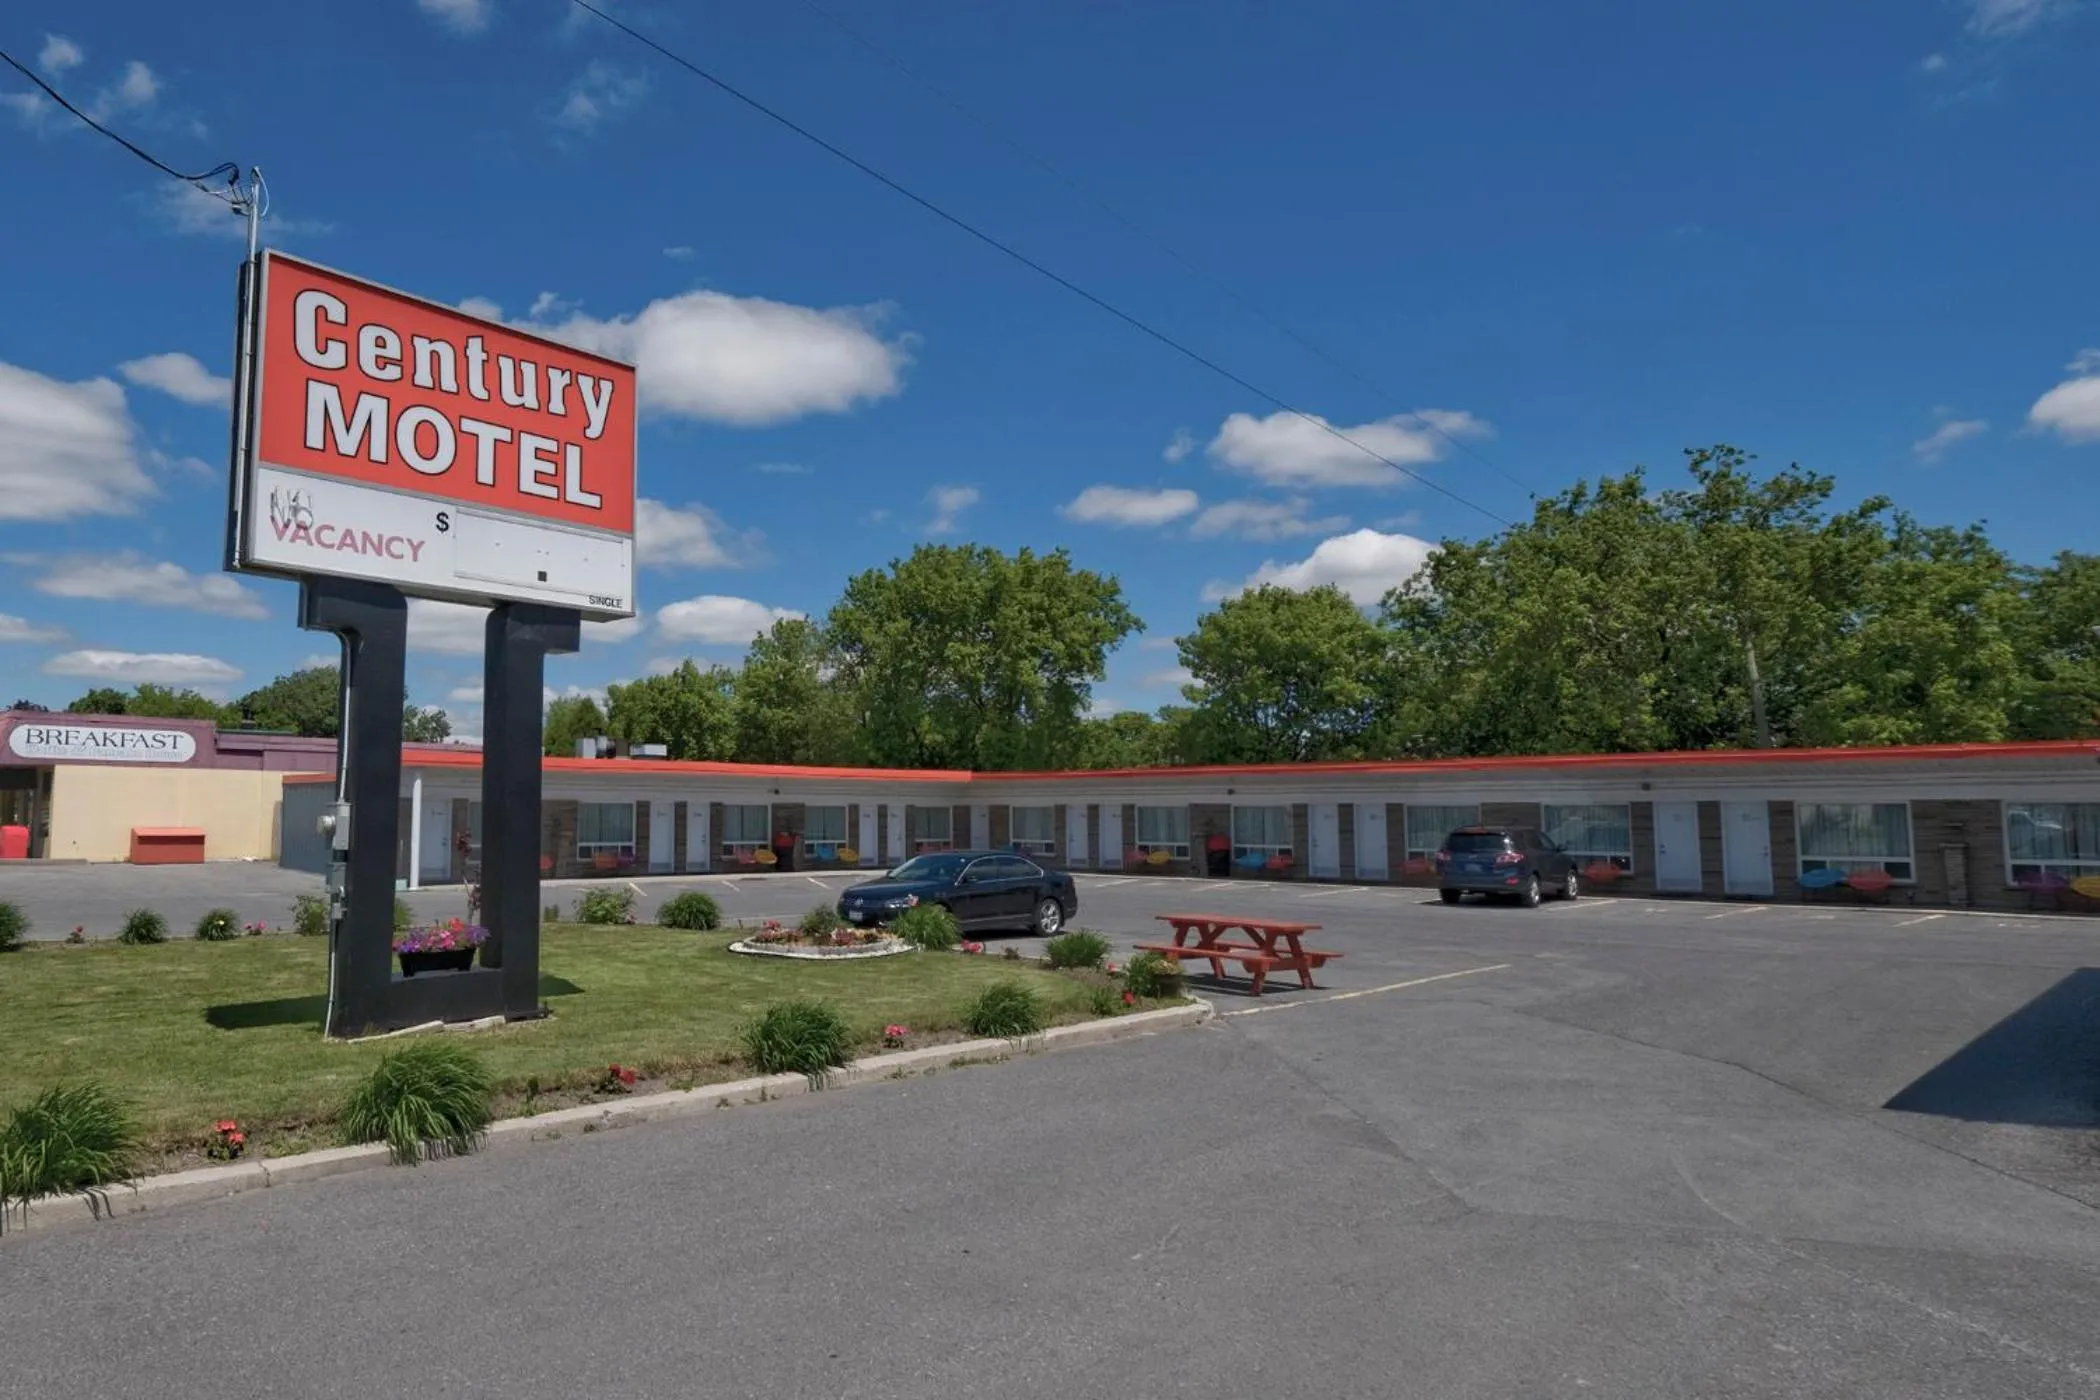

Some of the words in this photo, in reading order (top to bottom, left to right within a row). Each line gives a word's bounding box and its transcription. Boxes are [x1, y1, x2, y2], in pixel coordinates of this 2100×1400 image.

[295, 289, 613, 439] Century
[305, 378, 602, 509] MOTEL
[270, 515, 425, 562] VACANCY
[436, 511, 449, 533] $
[588, 594, 623, 608] SINGLE
[26, 728, 183, 750] BREAKFAST
